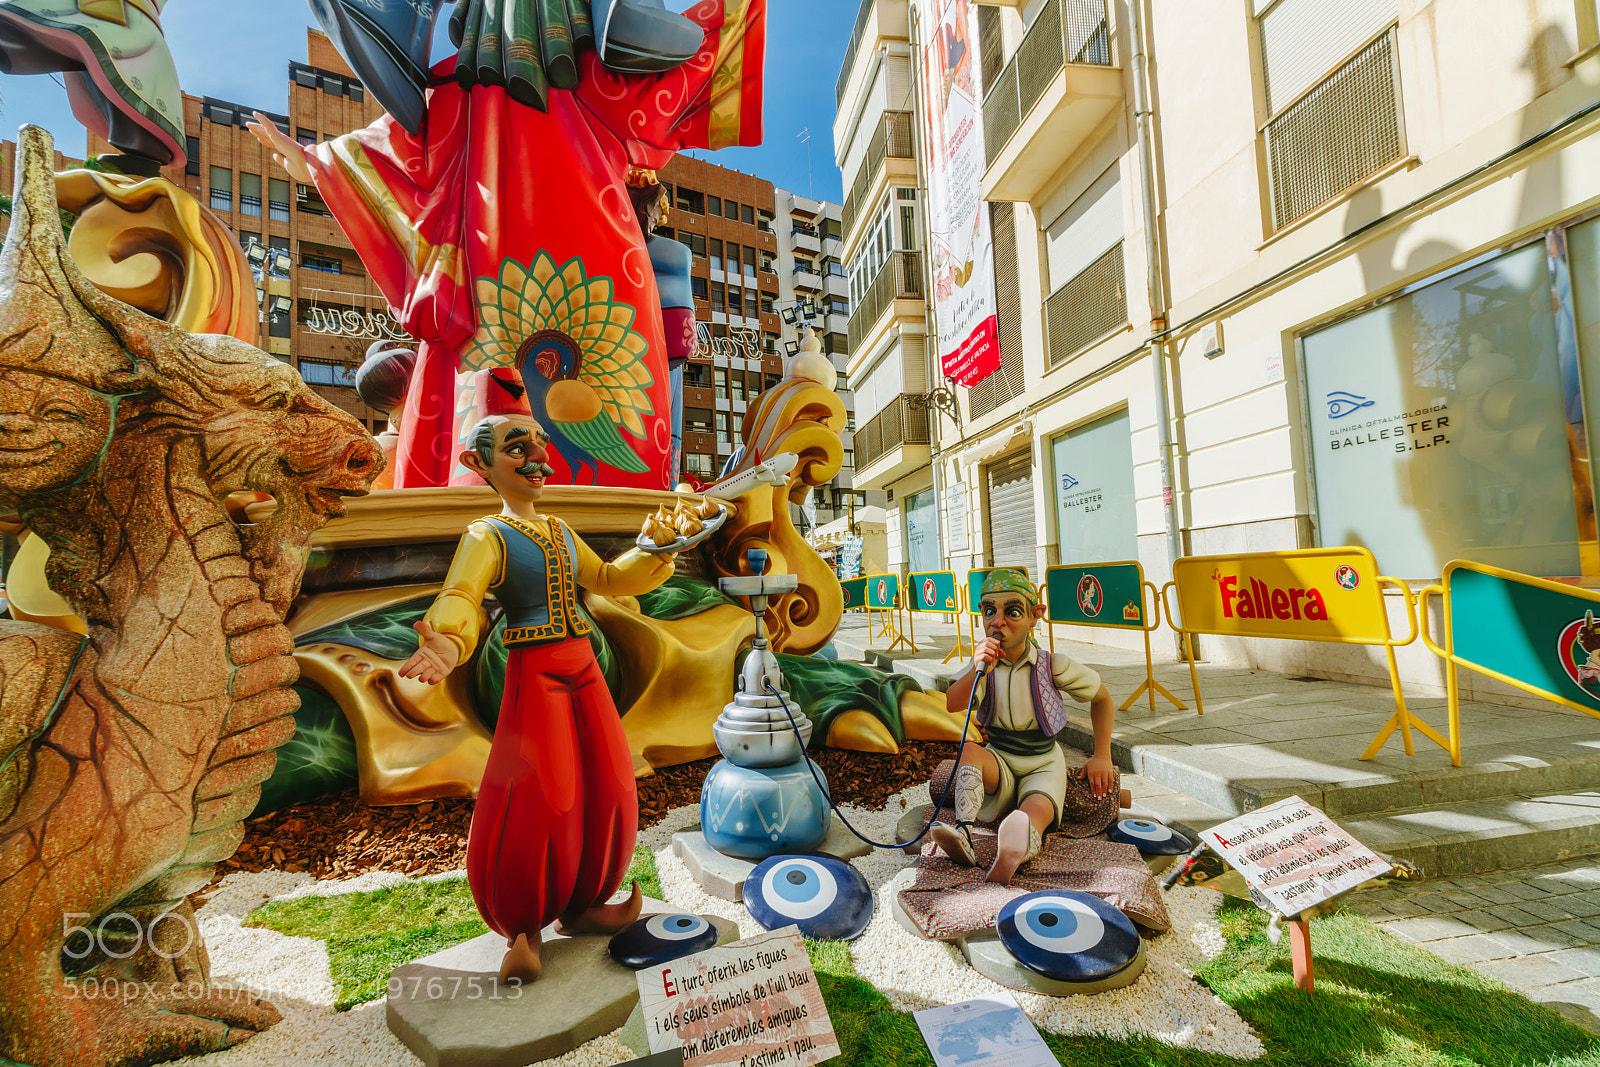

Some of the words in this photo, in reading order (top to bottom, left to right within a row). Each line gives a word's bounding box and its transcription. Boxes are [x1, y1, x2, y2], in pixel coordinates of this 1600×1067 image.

[1329, 423, 1363, 436] CLÍNICA
[1330, 416, 1450, 450] BALLESTER
[1395, 434, 1450, 453] S.L.P.
[1063, 494, 1103, 509] BALLESTER
[1218, 575, 1329, 621] Fallera
[1213, 829, 1258, 850] Assentat
[1257, 826, 1268, 835] en
[1265, 818, 1285, 831] rolls
[1281, 815, 1295, 825] de
[1292, 809, 1312, 821] seda
[1238, 854, 1249, 866] el
[1291, 832, 1308, 846] que
[1316, 848, 1330, 858] es
[1326, 838, 1351, 856] queda
[1317, 863, 1349, 883] fumant
[1341, 860, 1357, 871] la
[662, 968, 680, 998] El
[681, 973, 705, 993] turc
[707, 962, 738, 984] oferix
[738, 957, 755, 974] les
[756, 947, 788, 970] figues
[655, 1017, 660, 1035] i
[664, 1012, 680, 1032] els
[683, 1005, 709, 1025] seus
[711, 989, 751, 1016] símbols
[753, 982, 767, 1001] de
[788, 970, 810, 989] blau
[682, 1042, 699, 1061] om
[702, 1019, 765, 1054] deferències
[767, 1003, 808, 1030] amigues
[740, 1046, 786, 1067] d'estima
[786, 1039, 793, 1058] i
[793, 1035, 817, 1061] pau.
